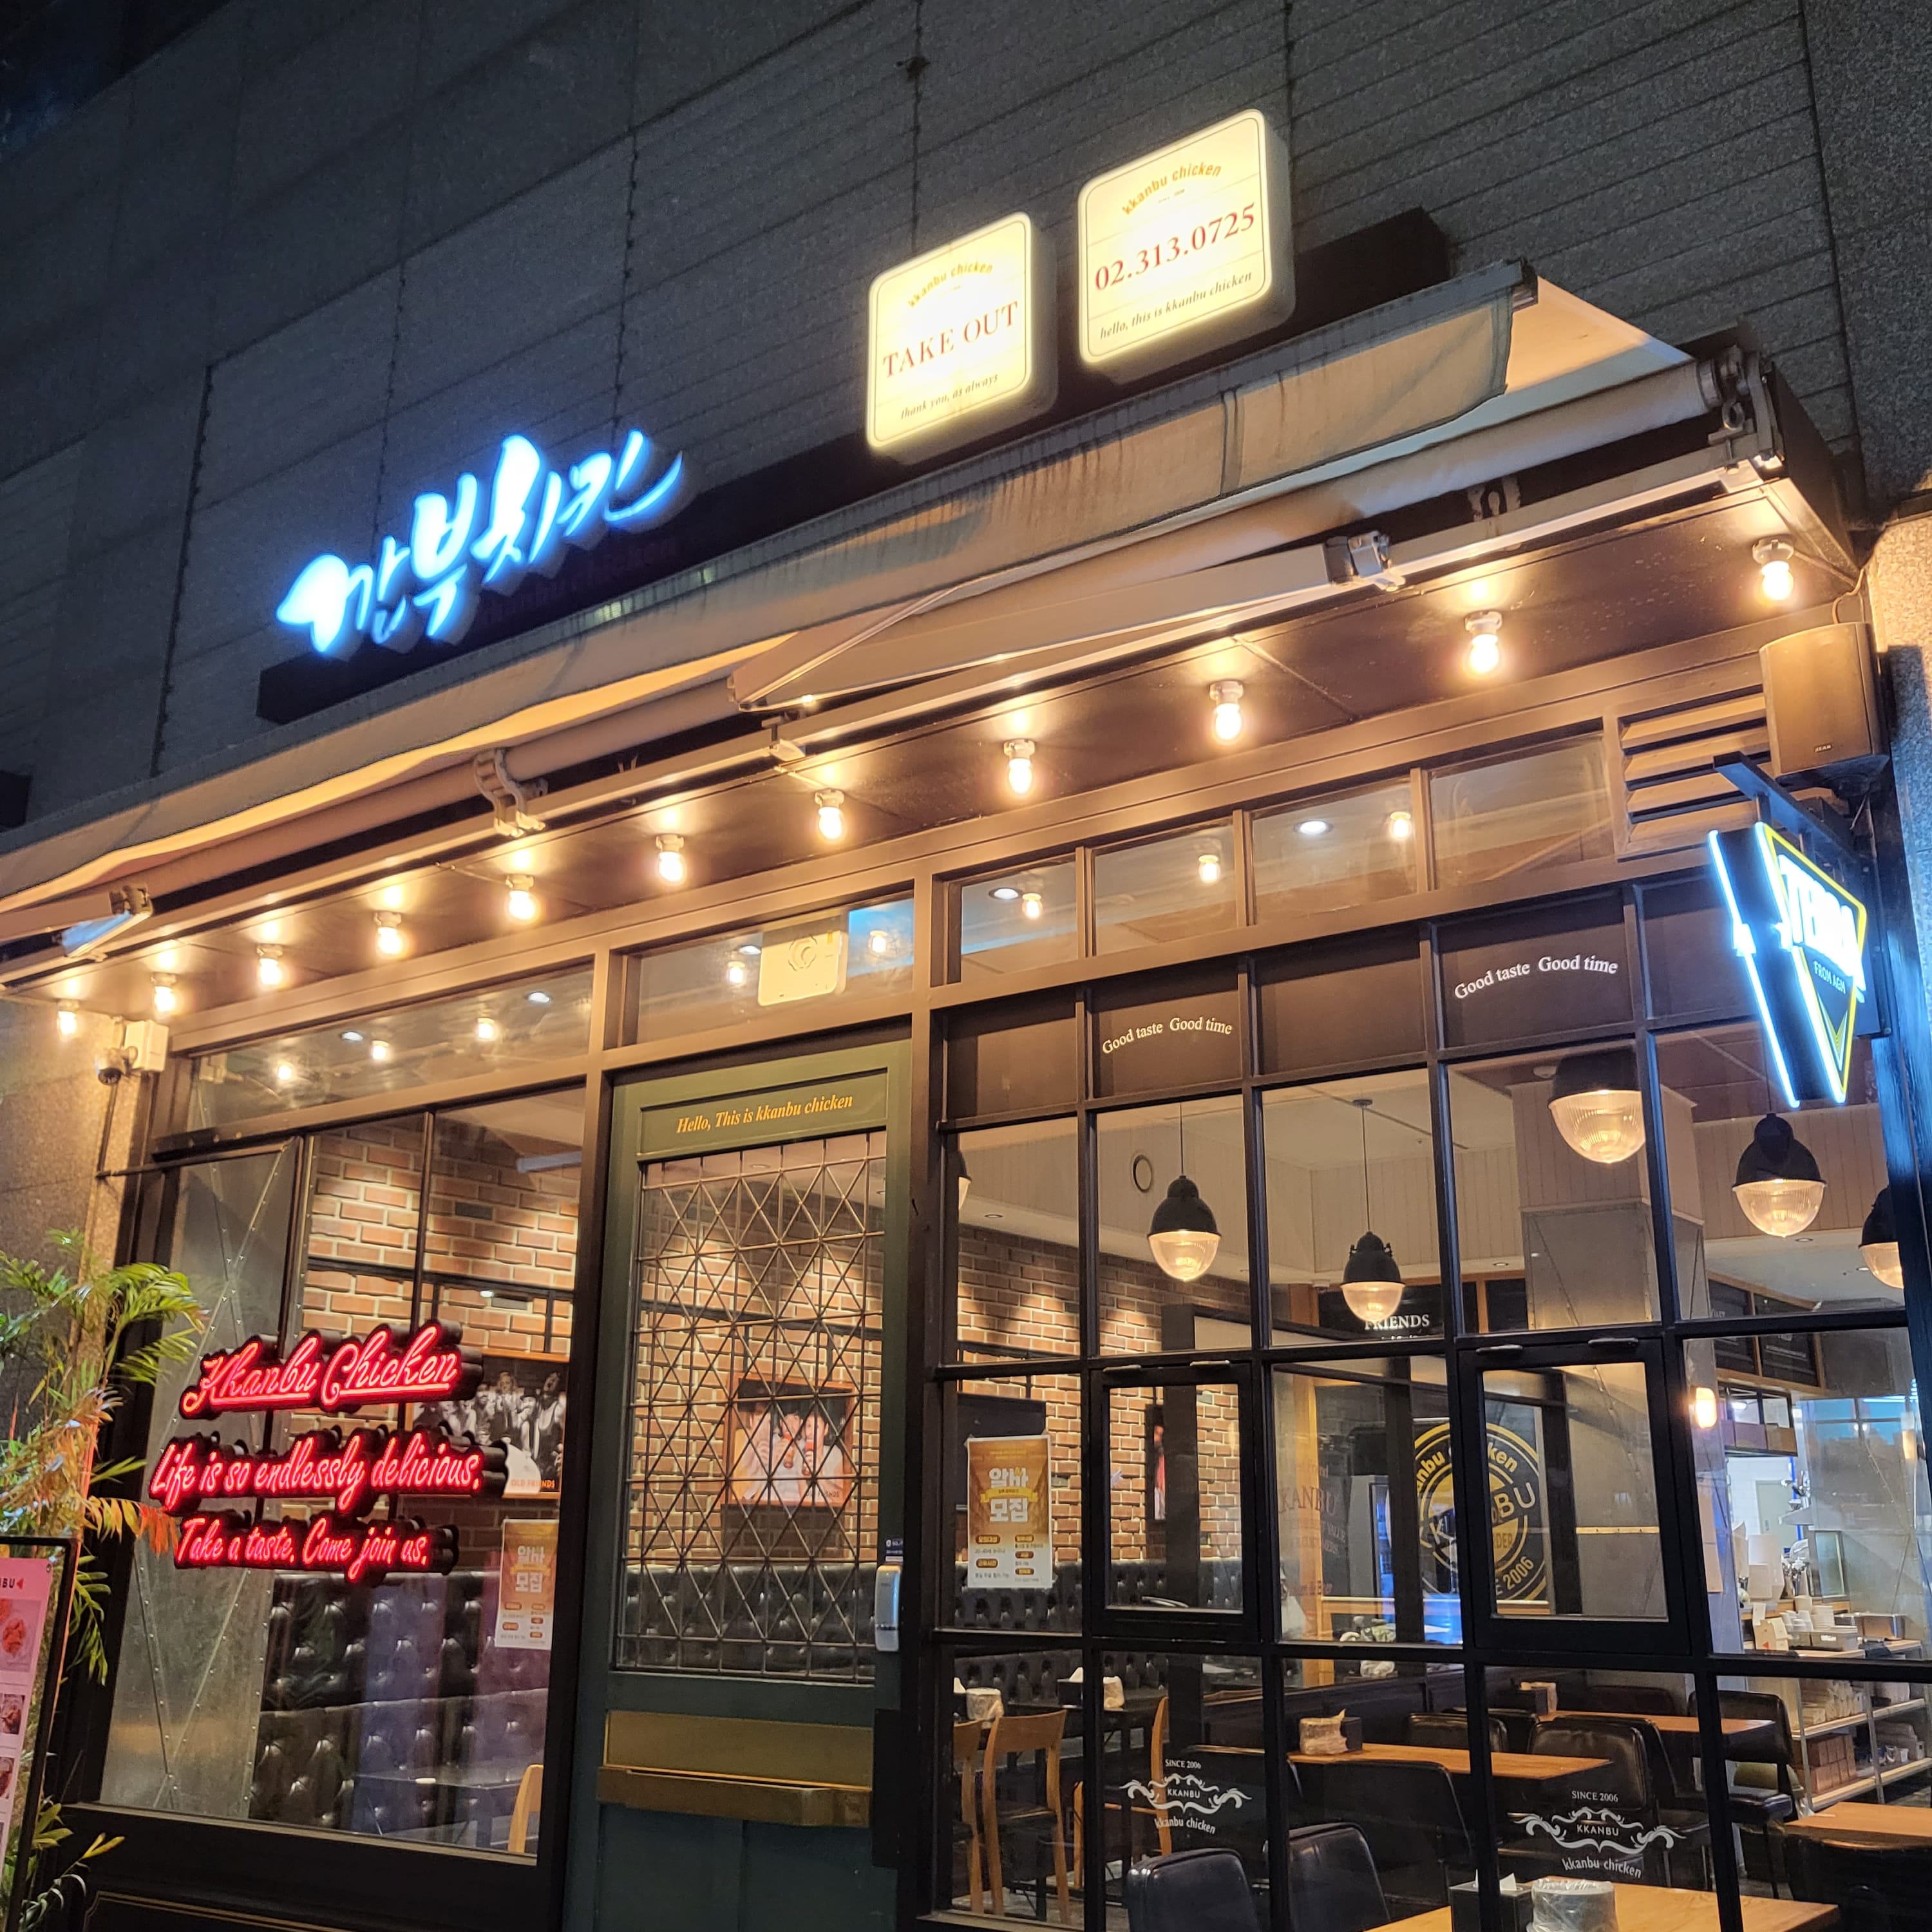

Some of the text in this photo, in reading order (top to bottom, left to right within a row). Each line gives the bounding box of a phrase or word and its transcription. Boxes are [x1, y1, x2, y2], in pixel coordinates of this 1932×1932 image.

[1122, 176, 1168, 215] kkanbu
[1172, 162, 1222, 182] chicken
[1095, 202, 1255, 291] 02.313.0725
[908, 272, 947, 308] kkanbu
[951, 261, 994, 278] chicken
[1100, 272, 1252, 340] hello, this is kkanbu chicken
[882, 301, 1018, 379] TAKE OUT
[901, 401, 927, 419] thank
[952, 388, 963, 399] as
[965, 374, 998, 394] always
[1454, 954, 1618, 999] Good taste Good time
[1102, 1016, 1233, 1054] Good taste Good time
[676, 1094, 854, 1134] Hello, This is kkanbu chicken
[321, 1325, 458, 1407] Chicken
[150, 1441, 196, 1511] Life
[198, 1452, 223, 1492] is
[224, 1464, 251, 1491] so
[256, 1435, 365, 1512] endlessly
[989, 1497, 1028, 1522] 모집
[177, 1517, 223, 1563] Take
[227, 1538, 241, 1561] a
[302, 1516, 353, 1565] Come
[346, 1527, 393, 1583] join
[1502, 1555, 1535, 1591] 2006
[1164, 1758, 1202, 1770] SINCE 2006
[1167, 1788, 1200, 1799] KKANBU
[1571, 1790, 1619, 1803] SINCE 2006
[1153, 1815, 1217, 1835] kkanbu chicken
[1577, 1824, 1620, 1837] KKANBU
[1561, 1856, 1642, 1879] kkanbu chicken
